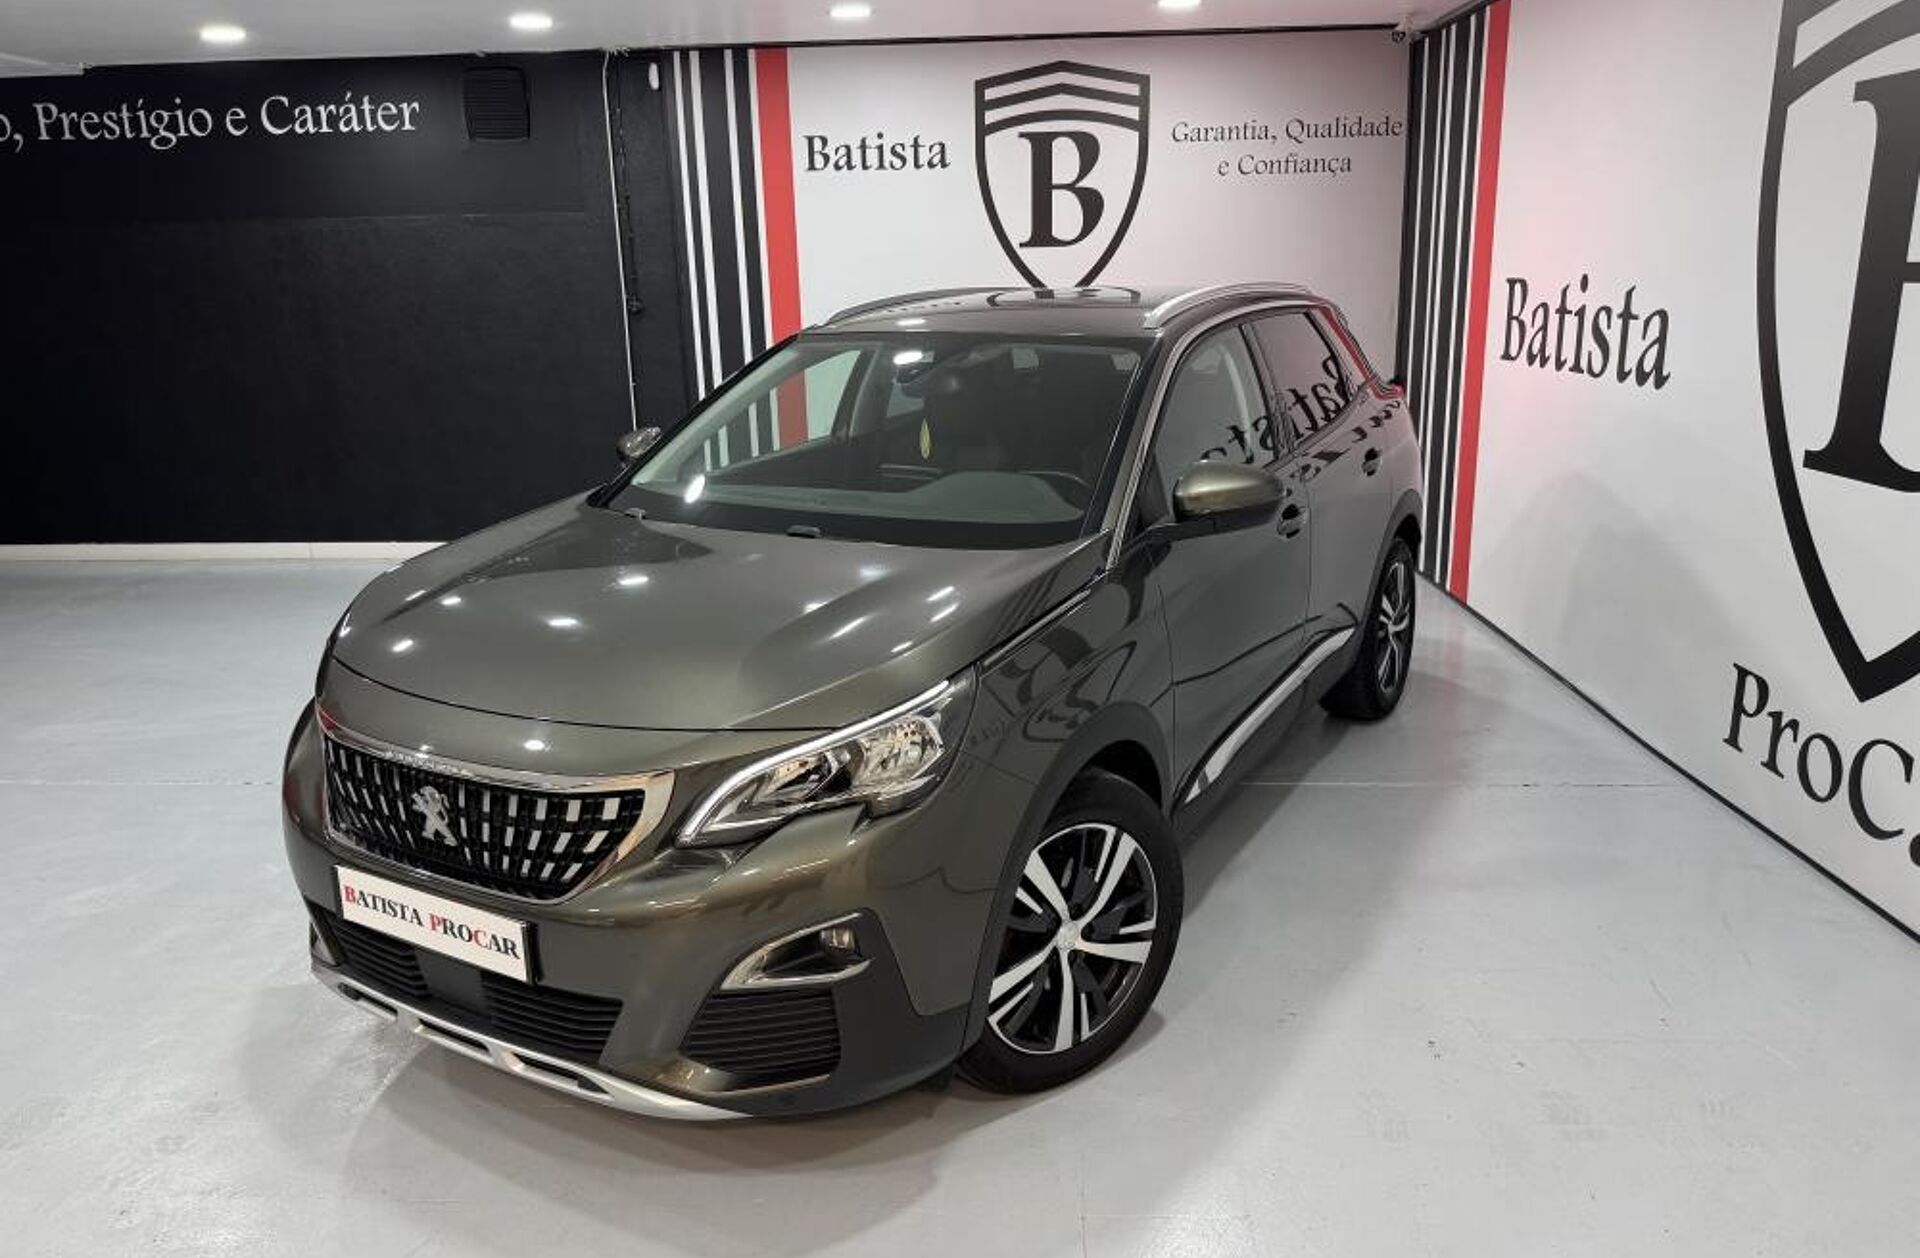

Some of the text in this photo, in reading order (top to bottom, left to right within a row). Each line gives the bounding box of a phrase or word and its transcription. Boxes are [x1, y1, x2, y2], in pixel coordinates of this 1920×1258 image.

[33, 97, 213, 150] Prestígio
[226, 108, 249, 136] e
[261, 91, 420, 135] Caráter
[1172, 115, 1403, 144] Garantia, Qualidade
[804, 132, 950, 171] Batista
[1218, 152, 1352, 177] e Confiança
[1018, 130, 1105, 248] B
[1501, 273, 1671, 390] Batista
[1722, 662, 1920, 868] ProC
[343, 886, 424, 927] BATISTA
